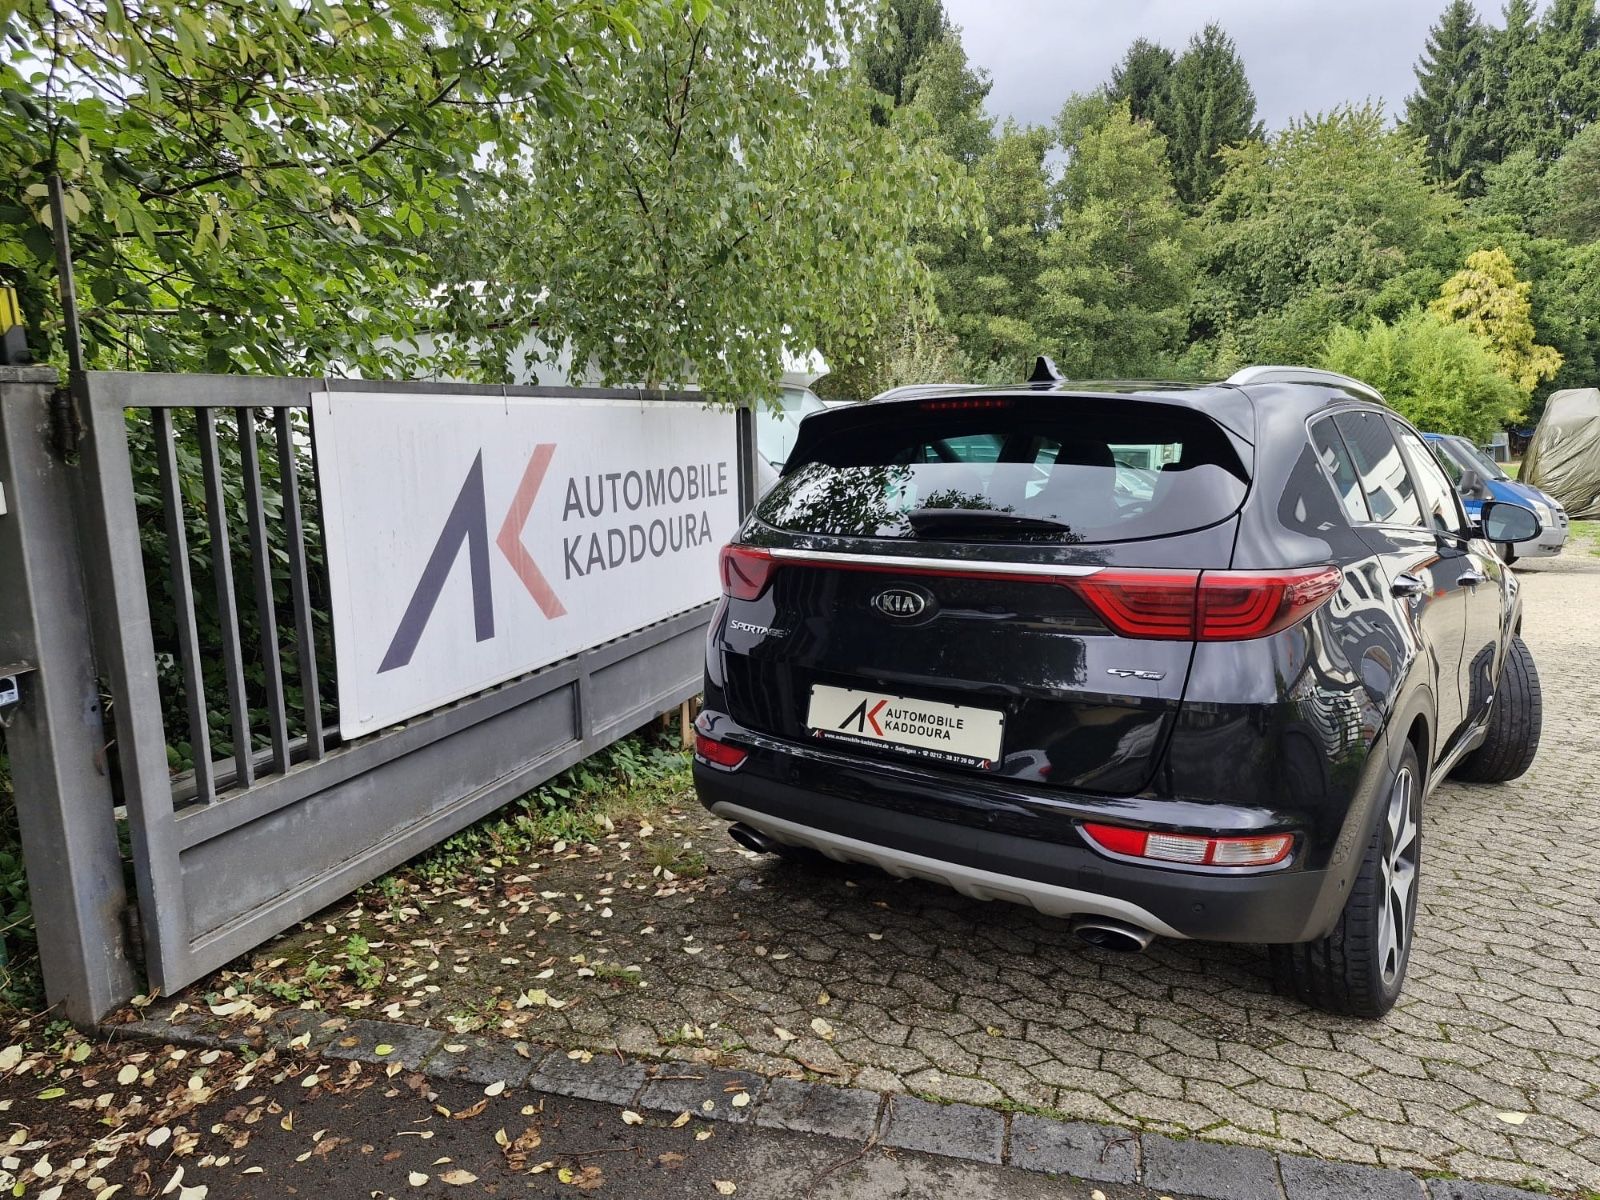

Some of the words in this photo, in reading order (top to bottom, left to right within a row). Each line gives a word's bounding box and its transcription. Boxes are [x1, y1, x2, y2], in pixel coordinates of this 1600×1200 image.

[562, 461, 728, 522] AUTOMOBILE
[563, 510, 713, 580] KADDOURA
[882, 594, 915, 613] KIA
[884, 720, 952, 741] KADDOURA
[885, 707, 965, 731] AUTOMOBILE
